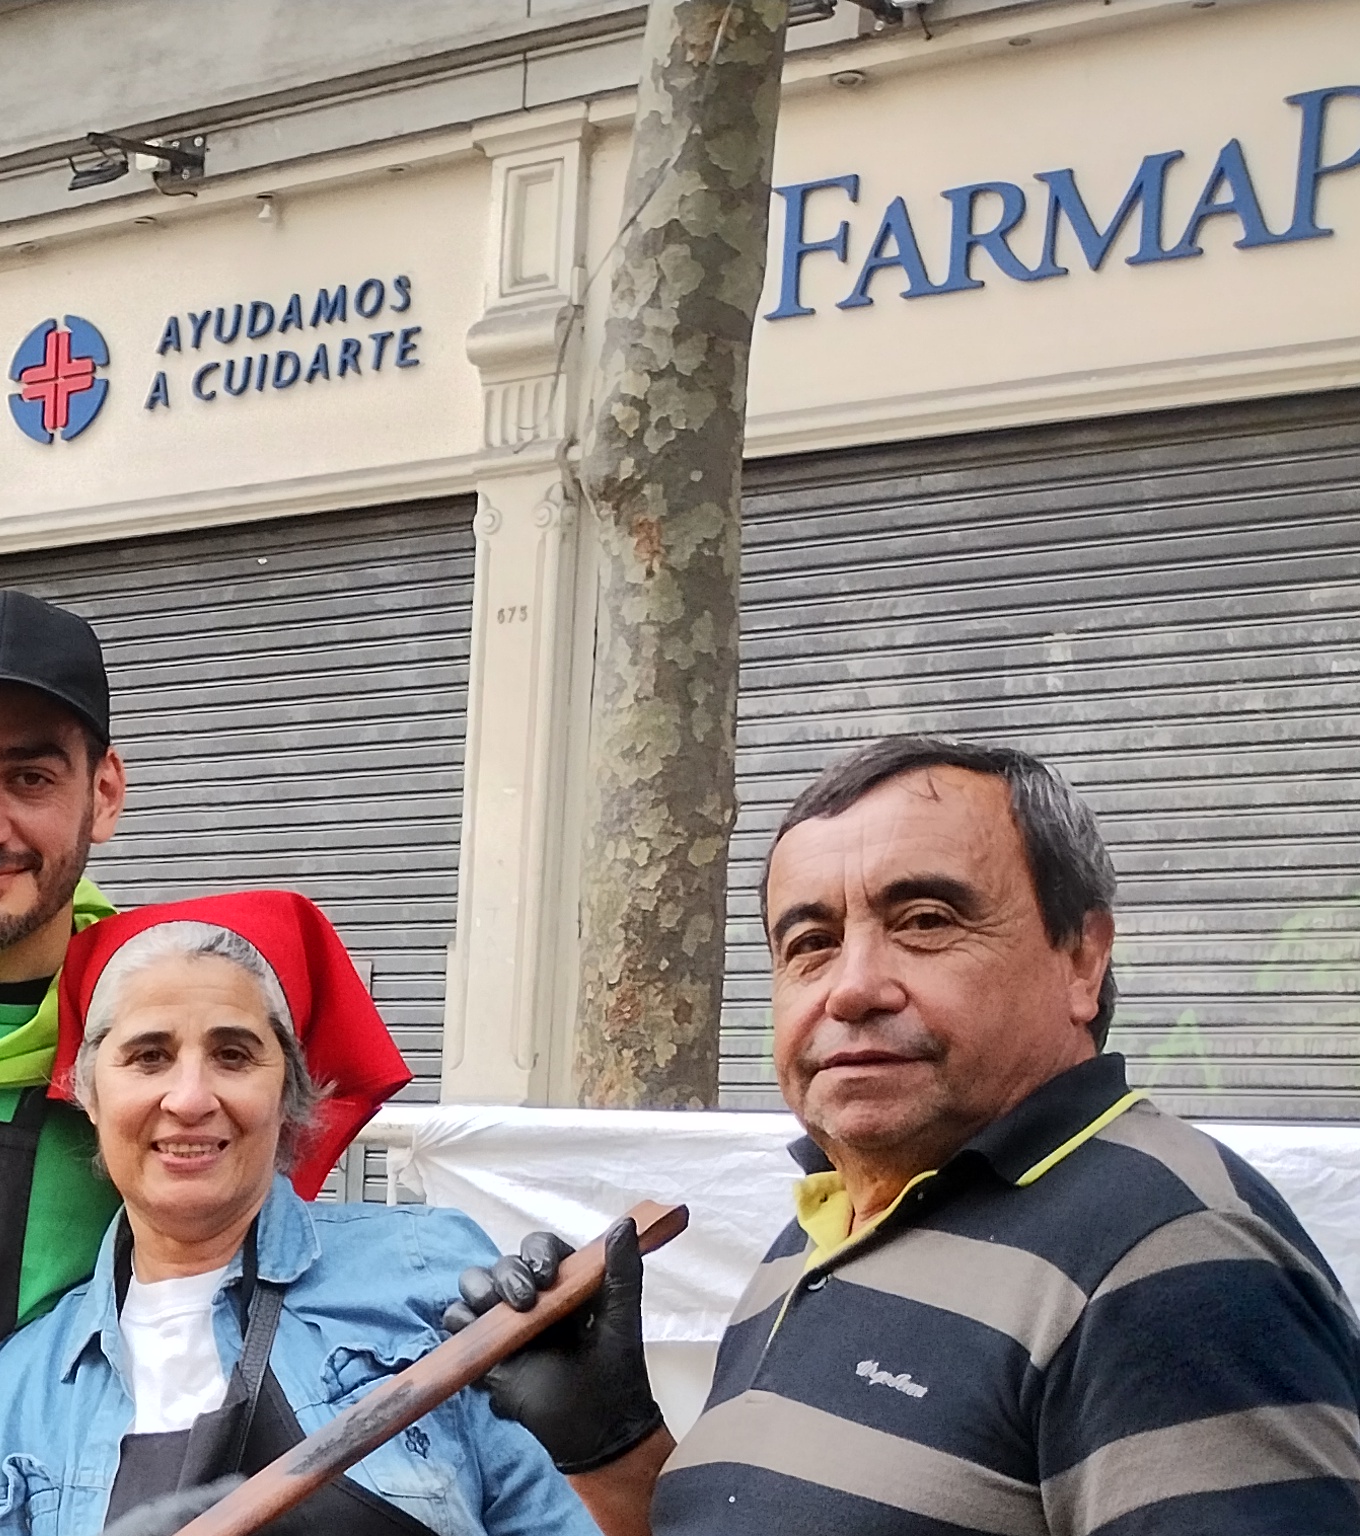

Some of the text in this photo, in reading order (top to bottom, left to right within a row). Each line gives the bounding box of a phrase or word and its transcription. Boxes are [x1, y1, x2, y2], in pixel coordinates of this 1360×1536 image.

[156, 274, 412, 356] AYUDAMOS
[144, 325, 422, 411] A CUIDARTE
